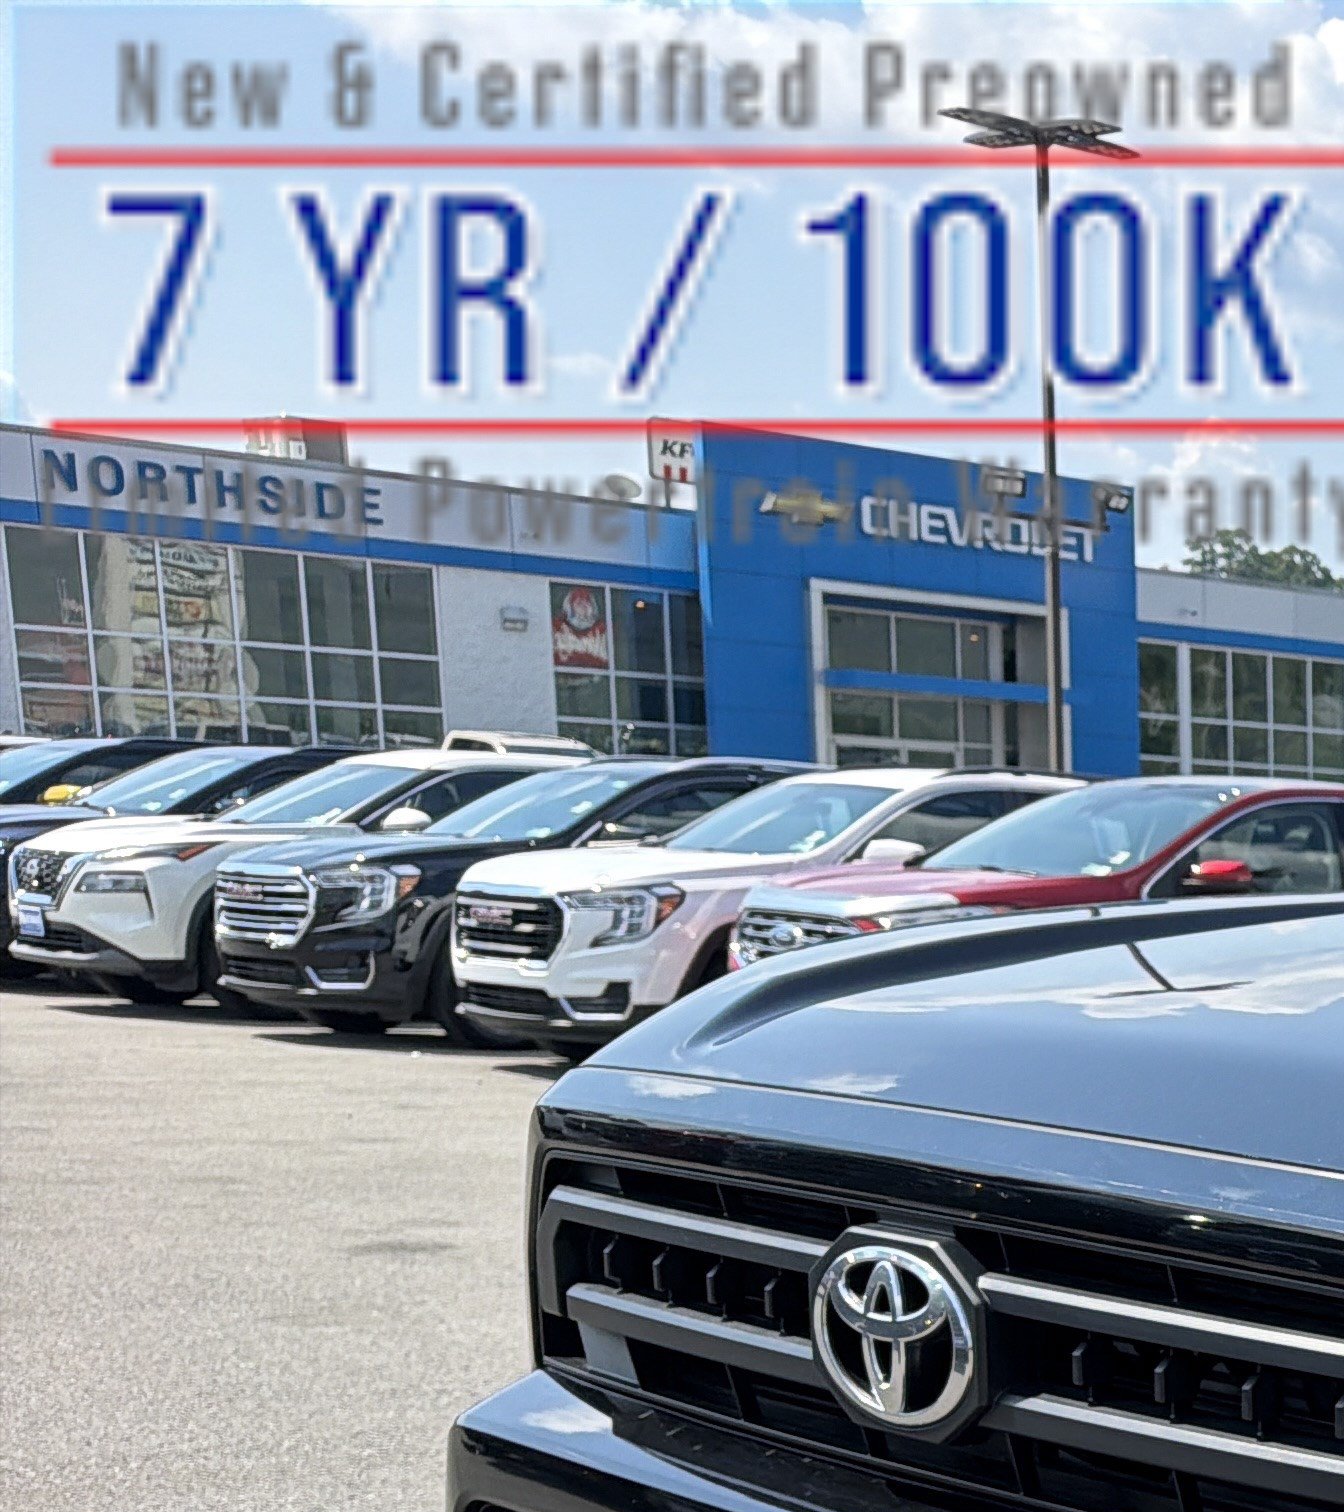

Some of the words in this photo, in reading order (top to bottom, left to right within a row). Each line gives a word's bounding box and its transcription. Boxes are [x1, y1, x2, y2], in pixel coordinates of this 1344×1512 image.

[660, 439, 696, 458] KF
[42, 448, 385, 526] NORTHSIDE
[861, 496, 1094, 563] CHEVROLET
